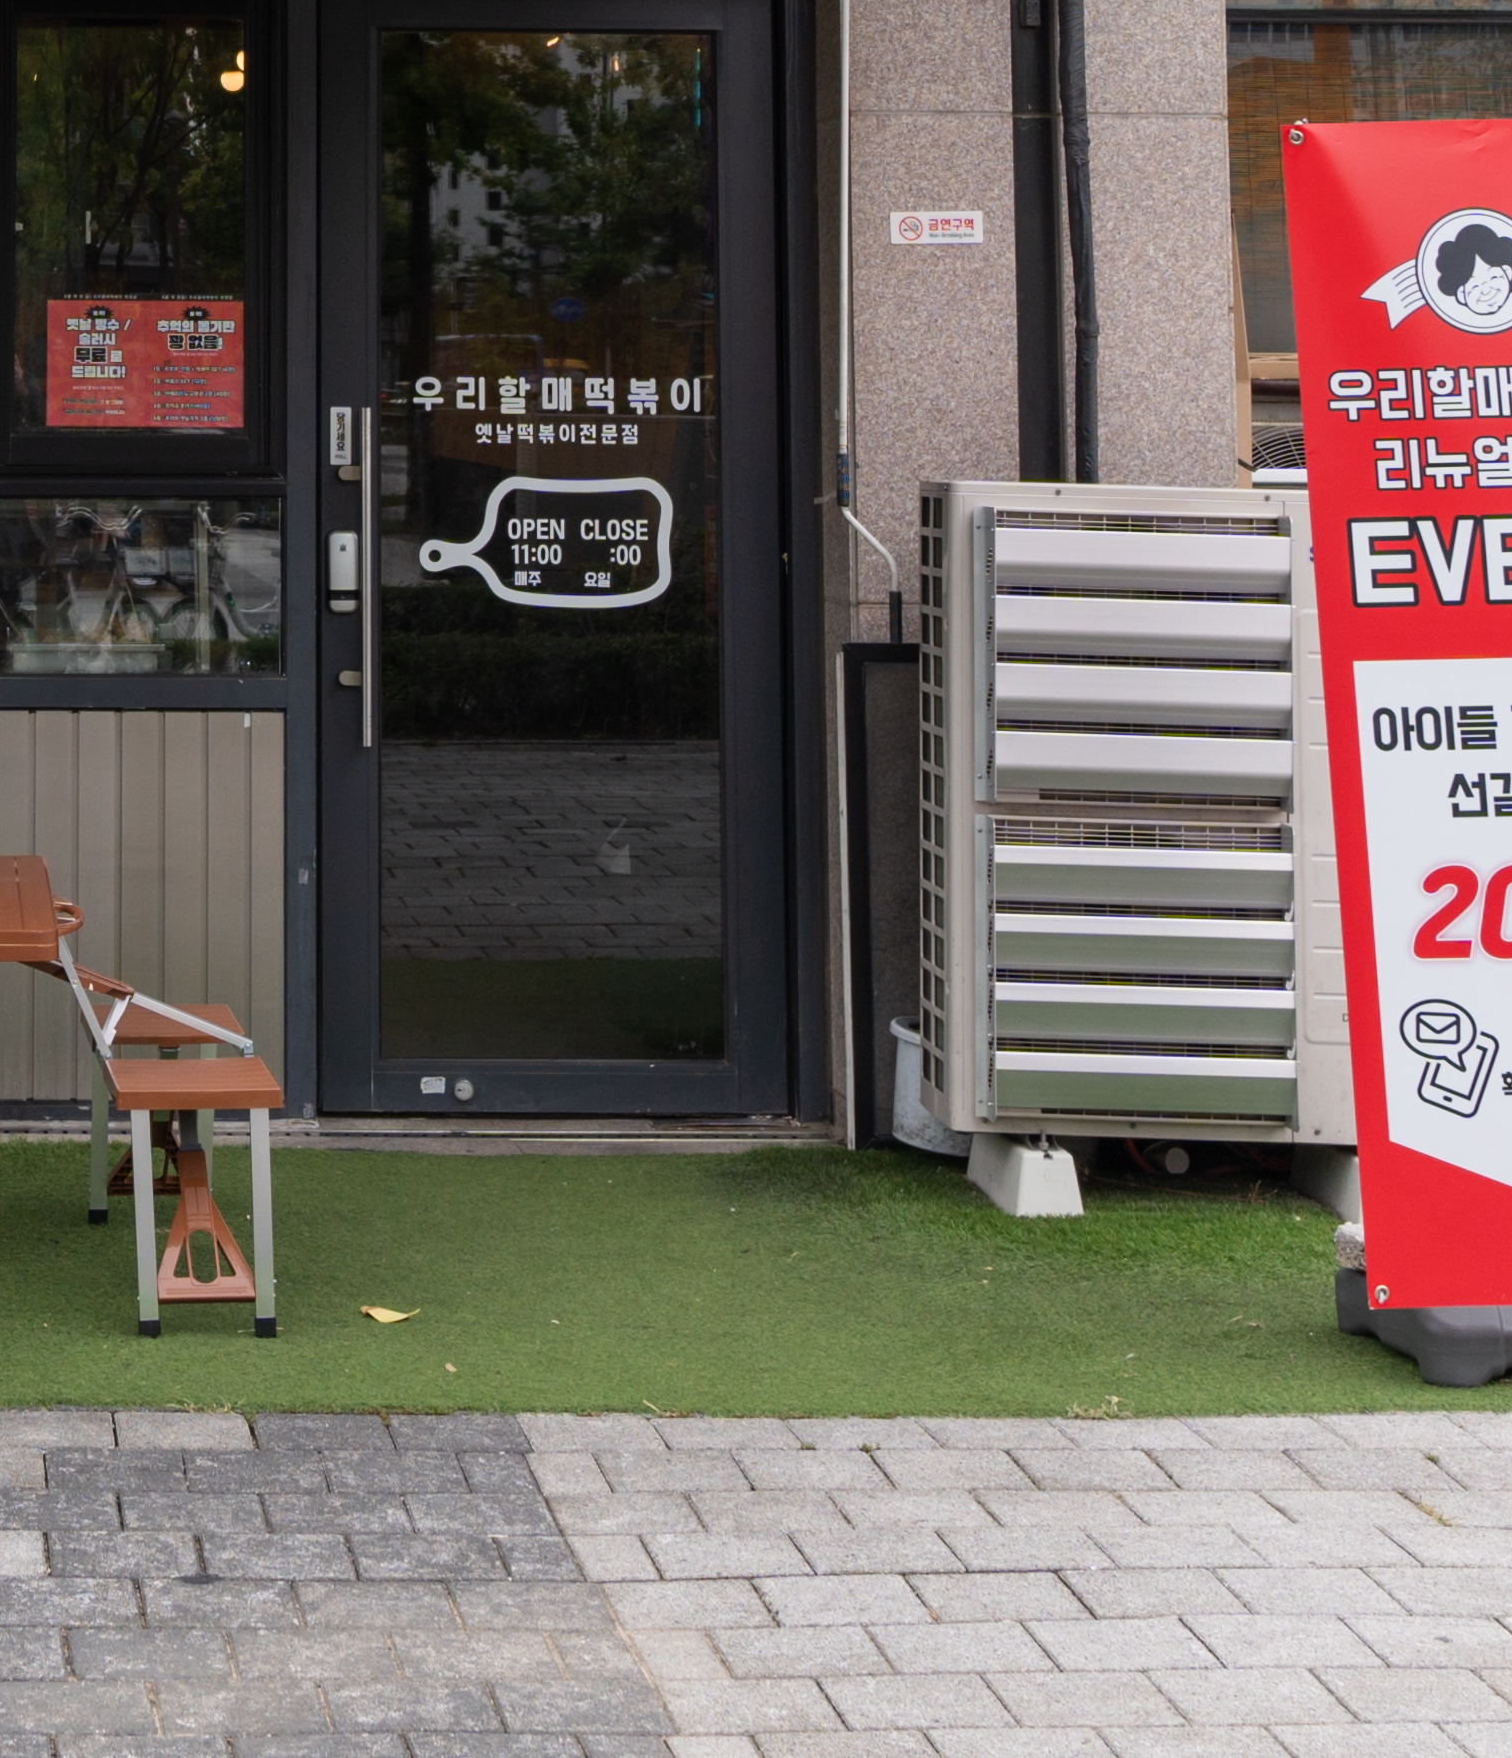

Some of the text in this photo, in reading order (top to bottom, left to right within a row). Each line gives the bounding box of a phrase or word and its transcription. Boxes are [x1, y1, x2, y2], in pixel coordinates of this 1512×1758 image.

[928, 218, 975, 231] 금연구역
[412, 376, 702, 416] 우리할매떡볶이
[474, 423, 639, 445] 옛날떡볶이전문점
[507, 518, 649, 541] OPEN CLOSE
[510, 544, 642, 565] 11:00 :00
[514, 570, 612, 588] 매주 요일
[1372, 704, 1499, 753] 아이들
